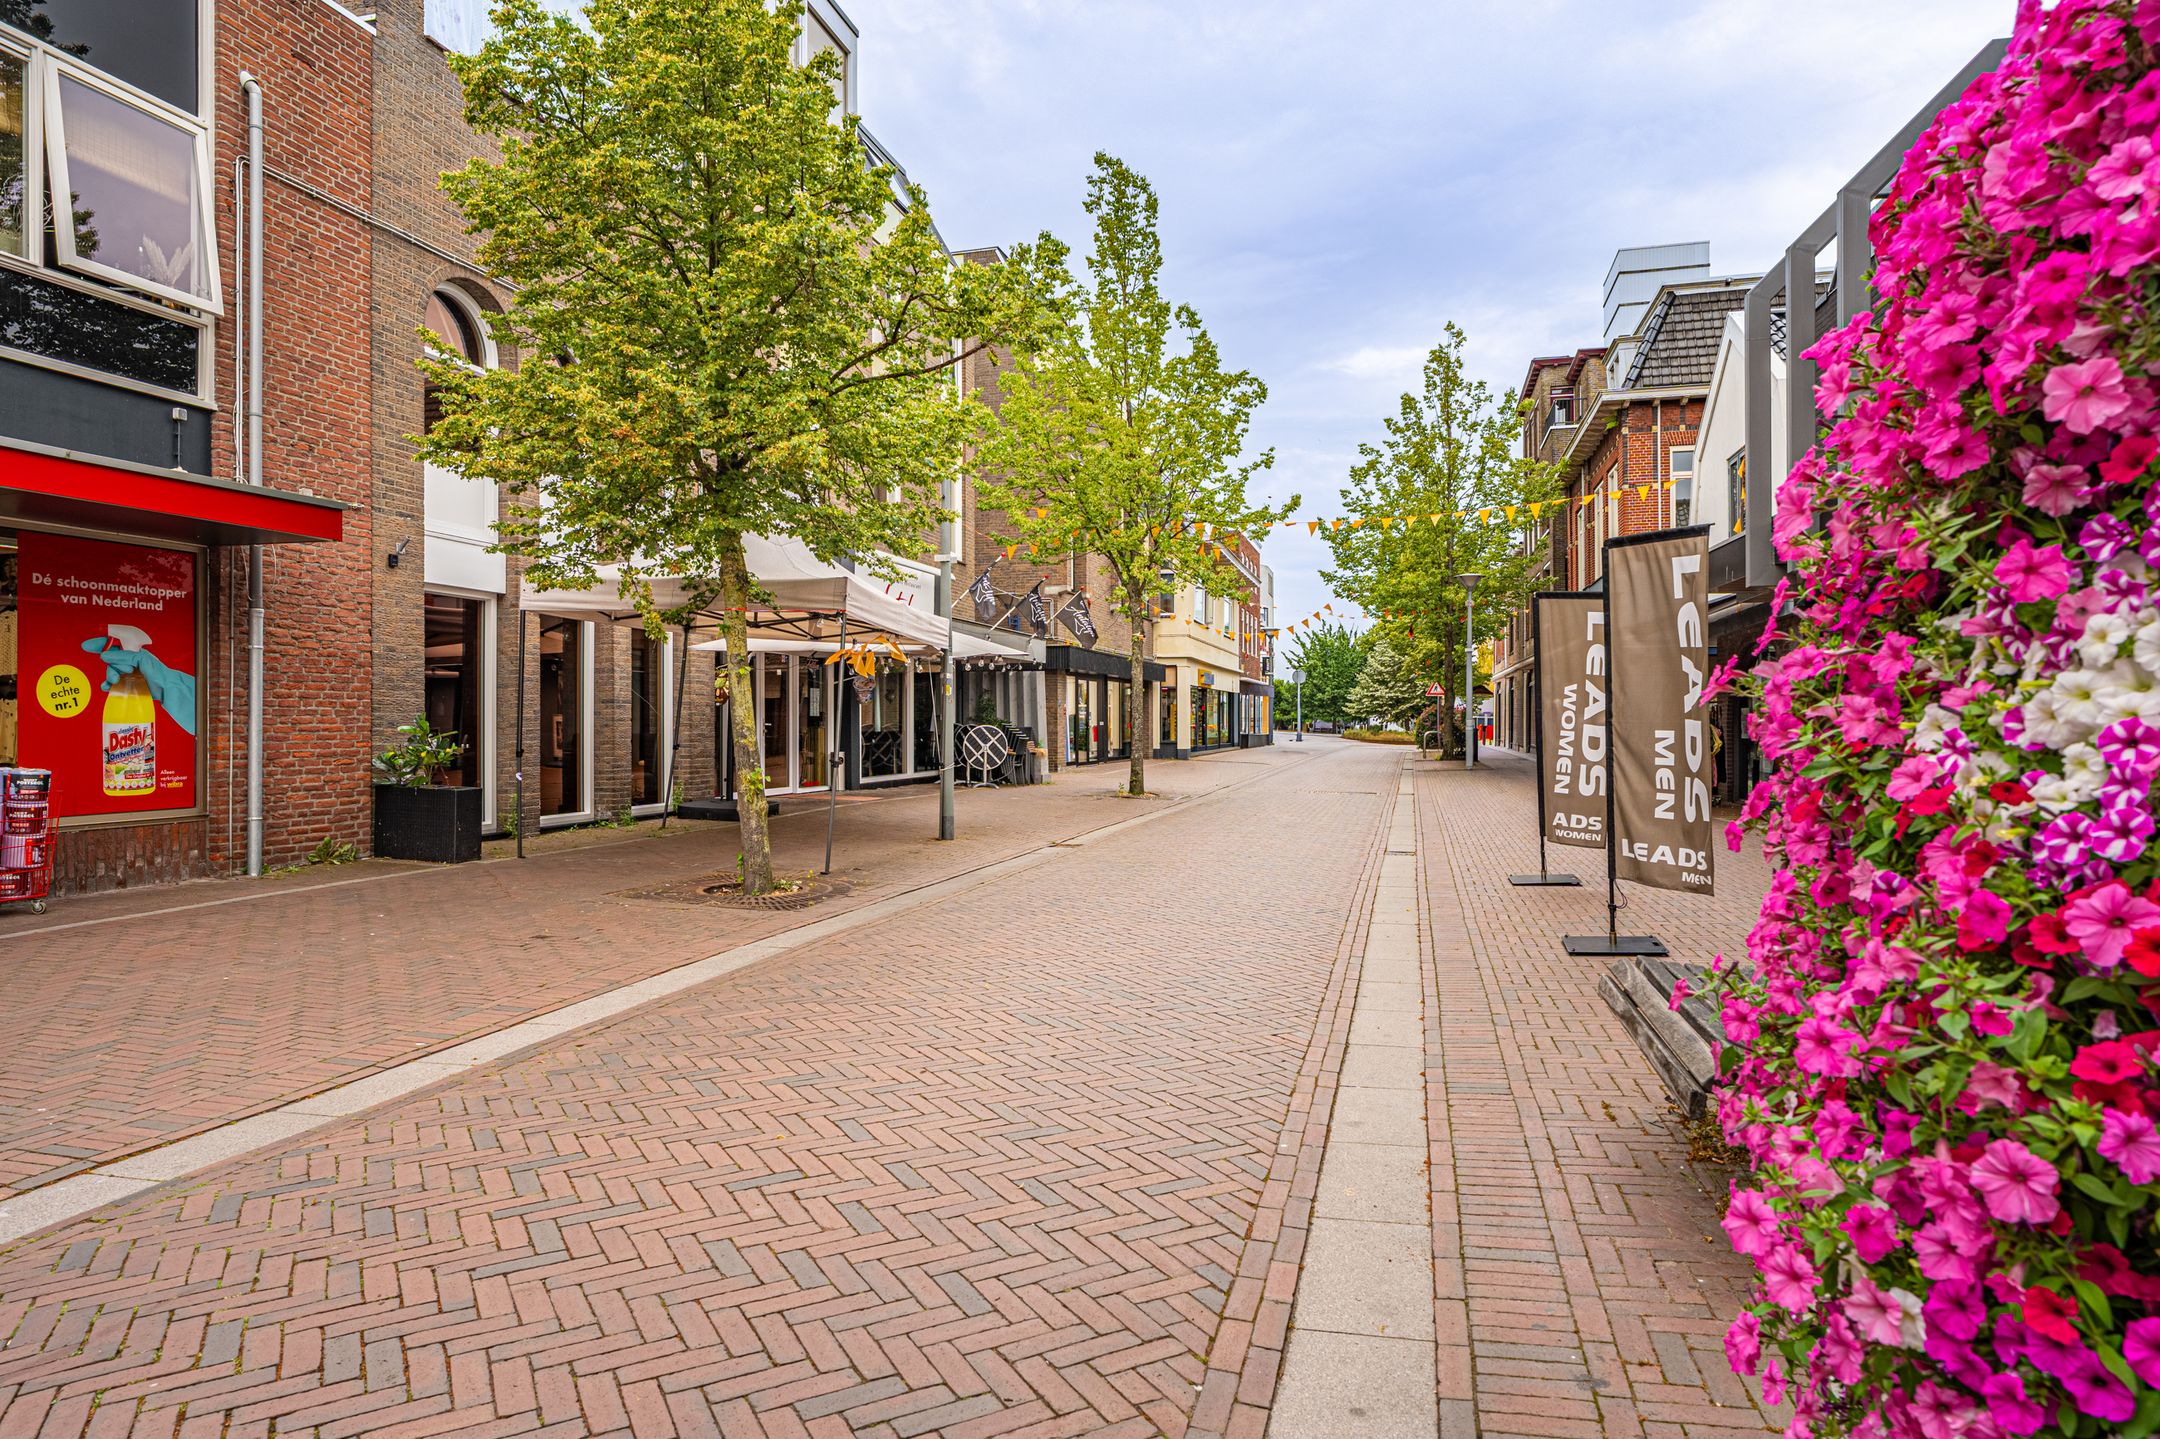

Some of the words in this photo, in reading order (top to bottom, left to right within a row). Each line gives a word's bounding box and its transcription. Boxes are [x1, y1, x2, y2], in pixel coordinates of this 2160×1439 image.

[32, 572, 52, 586] Dé
[56, 575, 187, 600] schoonmaaktopper
[60, 593, 88, 605] van
[92, 594, 164, 611] Nederland
[50, 686, 80, 699] echte
[54, 675, 71, 686] De
[1671, 554, 1710, 823] LEADS
[1578, 611, 1607, 797] LEADS
[109, 727, 147, 753] Dasty
[1554, 683, 1578, 795] WOMEN
[1654, 729, 1676, 820] MEN
[1554, 829, 1602, 842] WOMEN
[1621, 838, 1708, 871] LEADS
[1681, 871, 1713, 886] MEN
